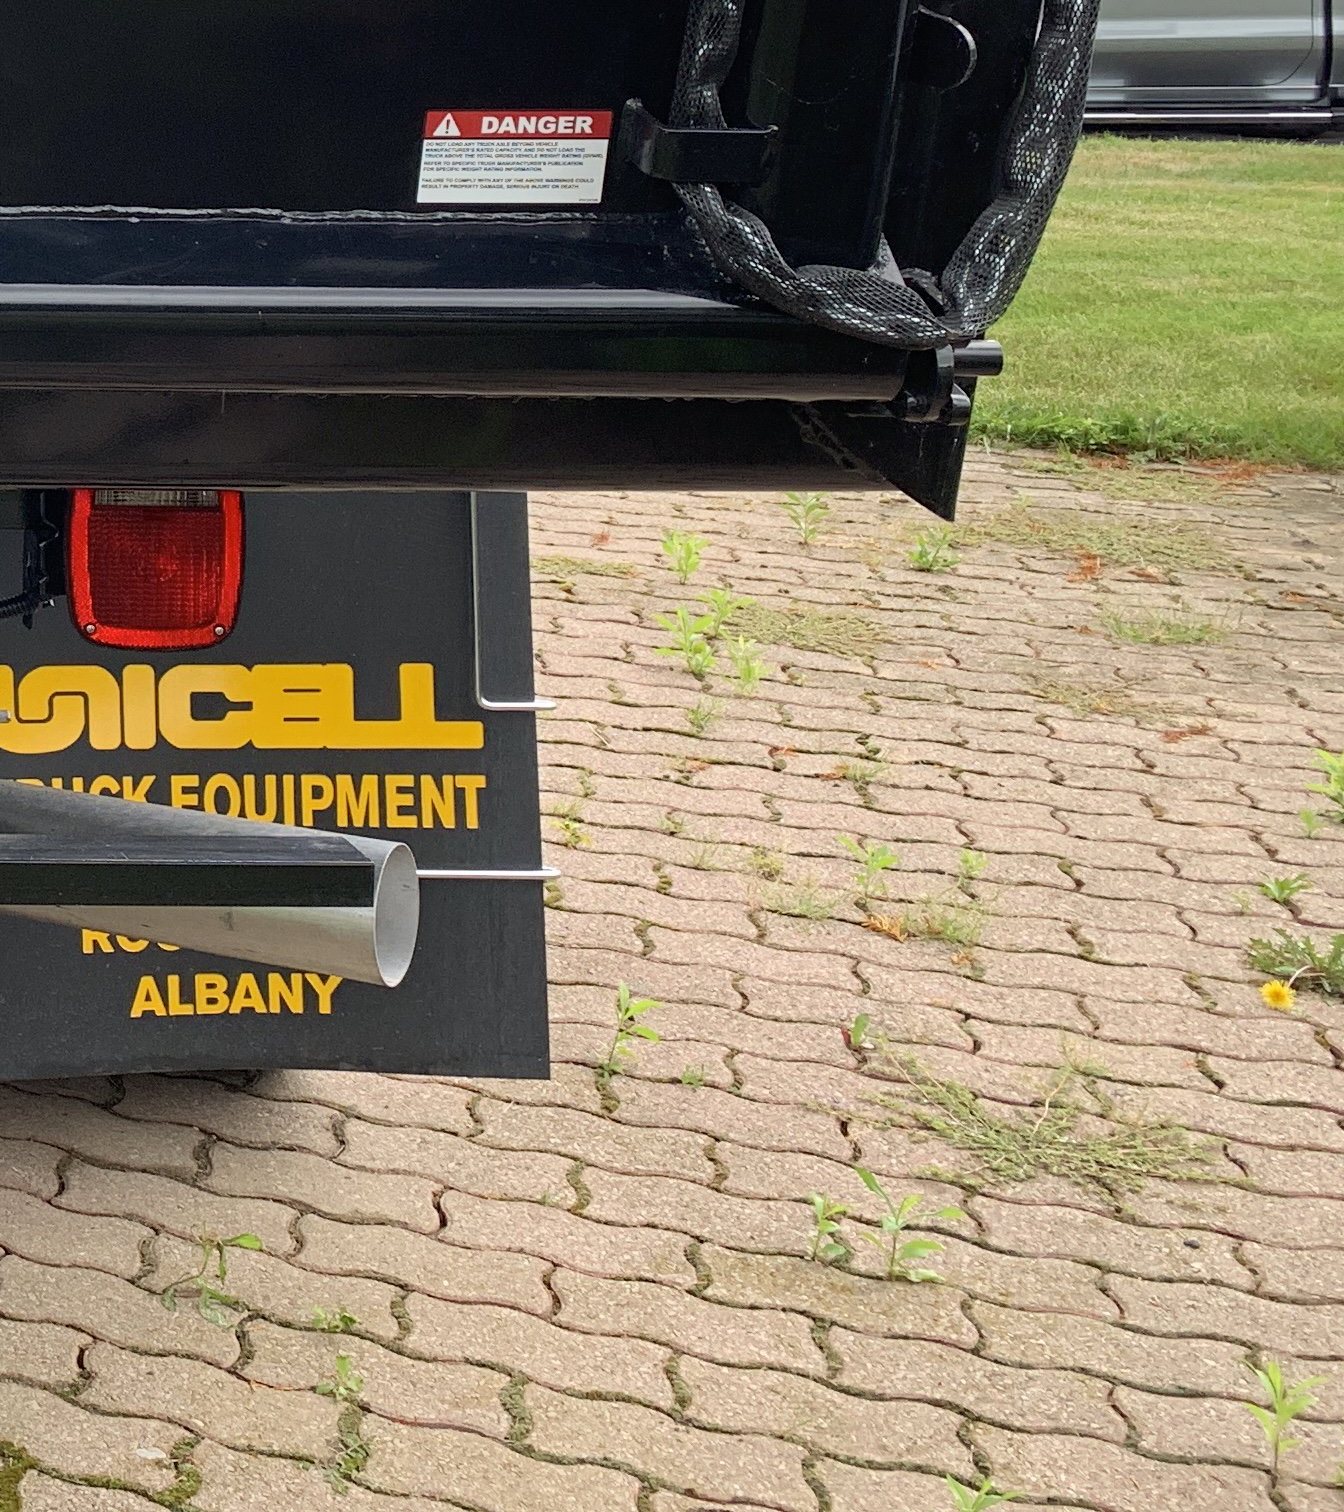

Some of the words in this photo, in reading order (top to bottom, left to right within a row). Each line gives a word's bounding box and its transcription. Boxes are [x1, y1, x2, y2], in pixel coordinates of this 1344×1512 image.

[480, 116, 593, 134] DANGER
[170, 774, 486, 829] EQUIPMENT
[129, 973, 345, 1019] ALBANY
